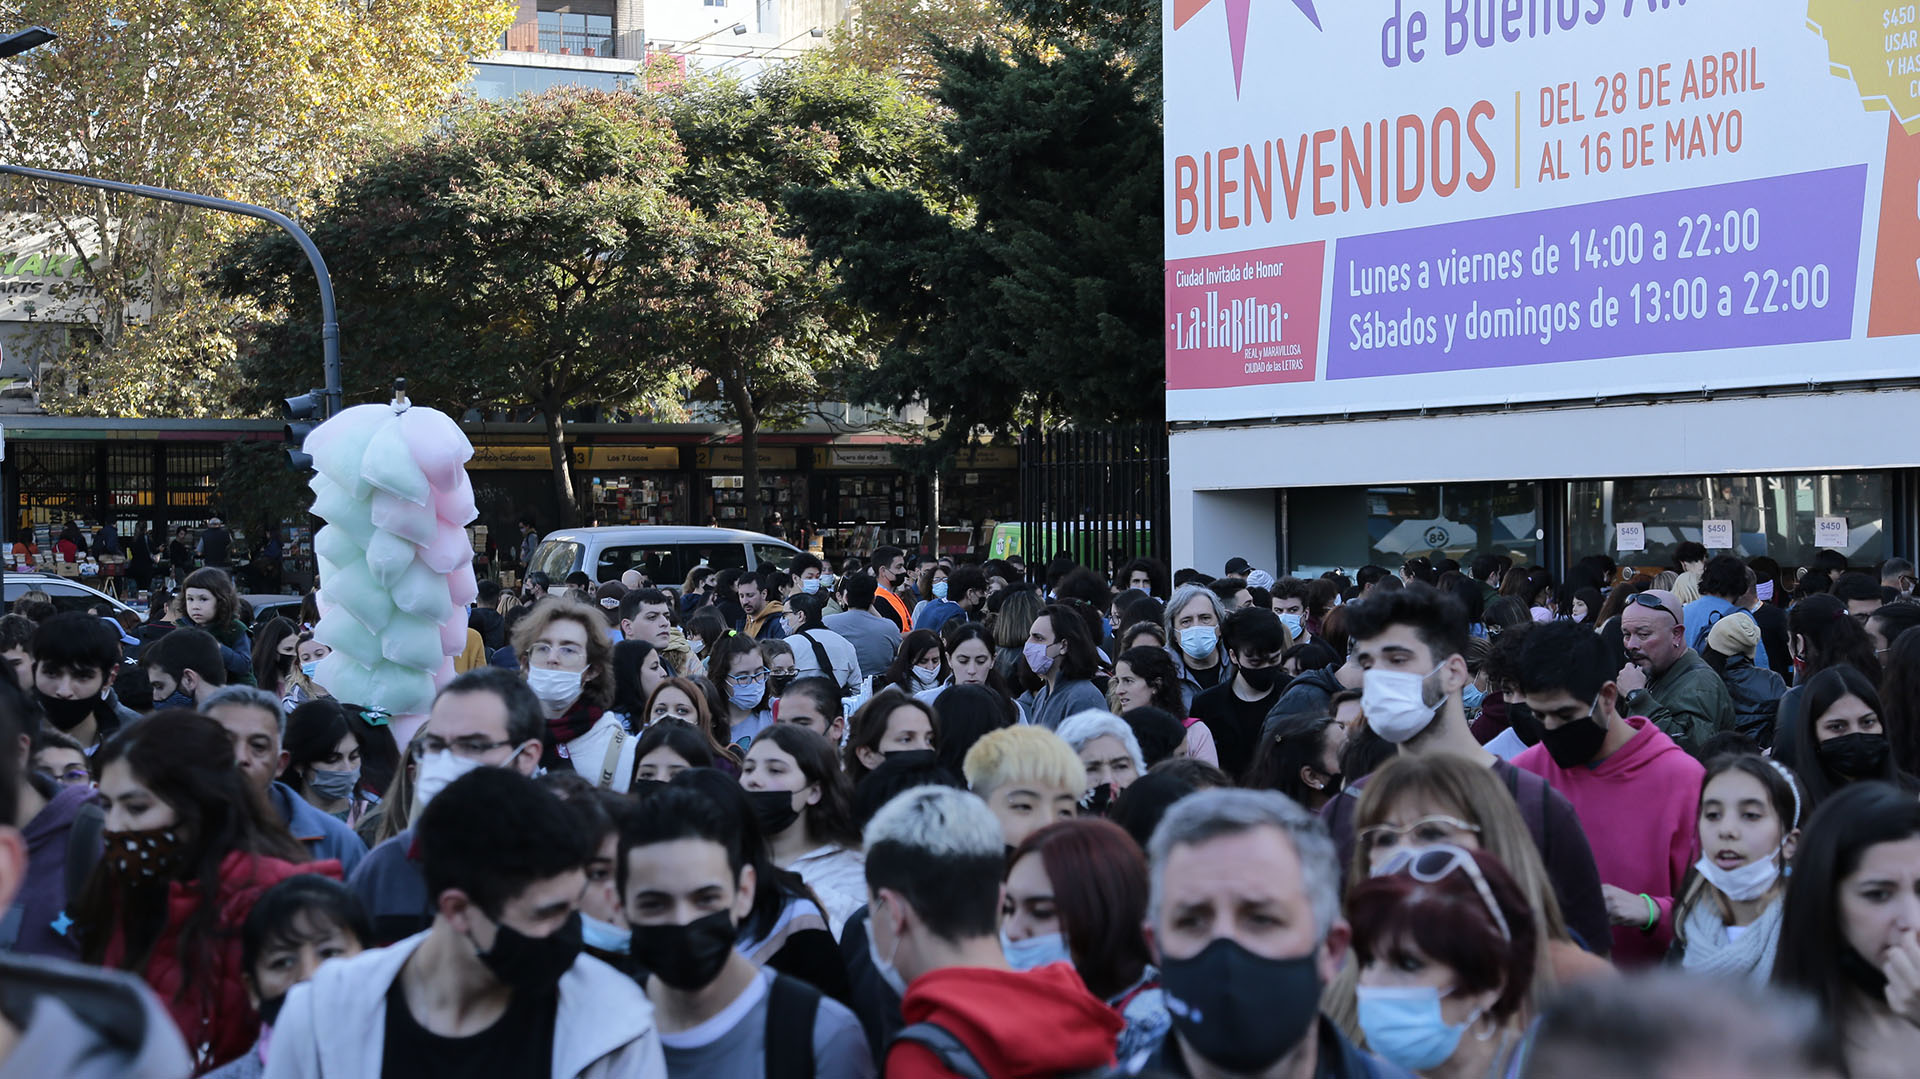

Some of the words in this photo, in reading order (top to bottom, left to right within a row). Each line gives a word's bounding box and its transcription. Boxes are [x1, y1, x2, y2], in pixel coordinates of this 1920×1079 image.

[1882, 5, 1915, 29] $450
[1382, 0, 1427, 67] de
[1885, 30, 1918, 52] USAR
[1886, 59, 1895, 77] Y
[1540, 81, 1585, 127] DEL
[1594, 72, 1627, 118] 28
[1638, 63, 1671, 109] DE
[1680, 47, 1765, 103] ABRIL
[1538, 139, 1570, 183] AL
[1580, 131, 1611, 175] 16
[1622, 123, 1655, 169] DE
[1666, 109, 1742, 163] MAYO
[1175, 100, 1496, 235] BIENVENIDOS
[1350, 260, 1411, 297] Lunes
[1418, 261, 1430, 289] a
[1437, 248, 1523, 287] viernes
[1531, 234, 1560, 276] de
[1569, 222, 1644, 271] 14:00
[1652, 230, 1667, 261] a
[1677, 207, 1760, 259] 22:00
[1176, 267, 1204, 288] Ciudad
[1206, 263, 1241, 285] Invitada
[1243, 261, 1254, 280] de
[1256, 260, 1283, 279] Honor
[1350, 307, 1437, 350] Sábados
[1444, 313, 1458, 353] y
[1465, 298, 1581, 345] domingos
[1590, 286, 1619, 328] de
[1630, 276, 1708, 324] 13:00
[1717, 285, 1732, 316] a
[1743, 263, 1829, 315] 22:00
[1245, 348, 1258, 359] REAL
[1259, 350, 1263, 361] y
[1263, 344, 1301, 358] MARAVILLOSA
[1245, 361, 1265, 374] CIUDAD
[1266, 361, 1273, 372] de
[1273, 361, 1281, 372] las
[1282, 359, 1304, 371] LETRAS
[607, 454, 619, 462] Los
[115, 494, 134, 505] 160
[1621, 527, 1639, 536] $450
[1707, 524, 1727, 533] $450
[1820, 522, 1841, 531] $450
